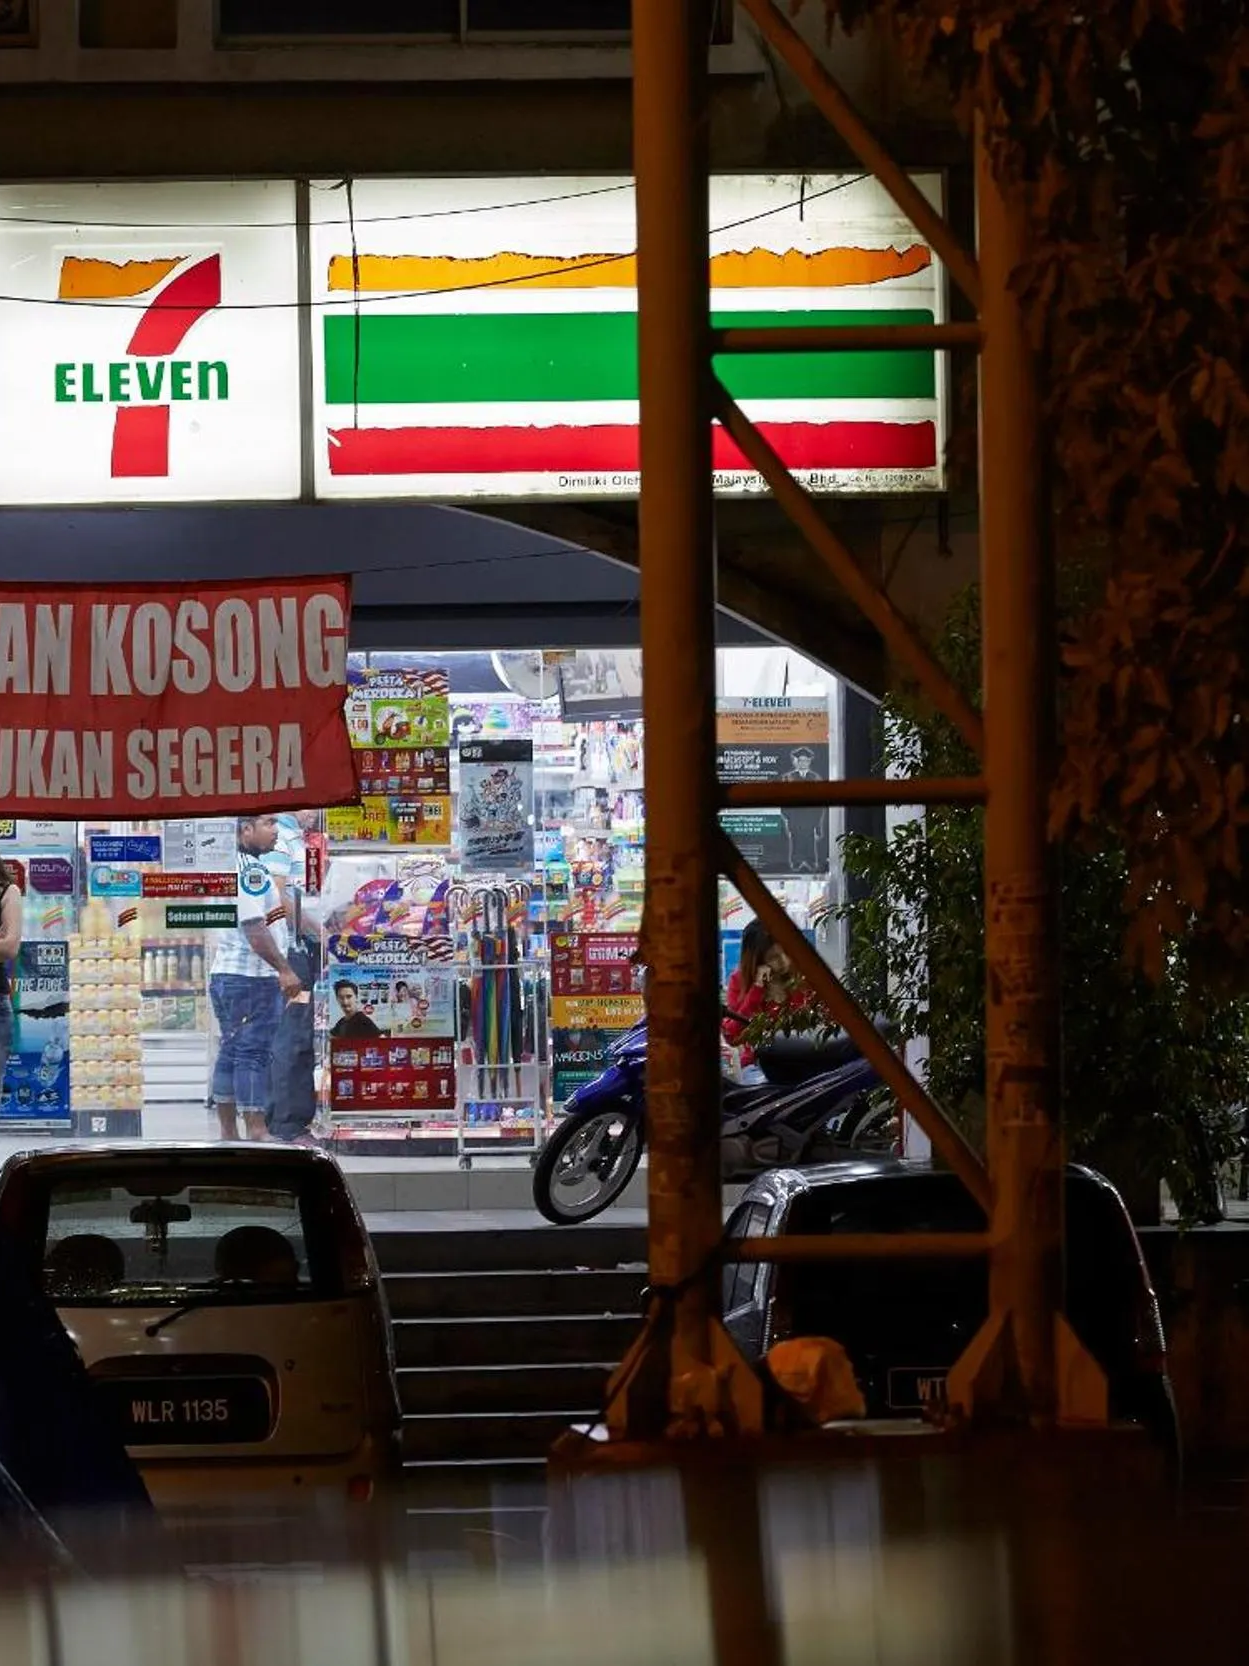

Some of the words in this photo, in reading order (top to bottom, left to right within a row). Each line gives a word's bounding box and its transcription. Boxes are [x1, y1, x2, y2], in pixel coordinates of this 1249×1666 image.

[58, 253, 222, 479] 7
[89, 593, 347, 697] KOSONG
[125, 722, 306, 800] SEGERA
[131, 1400, 175, 1423] WLR
[182, 1399, 229, 1422] 1135
